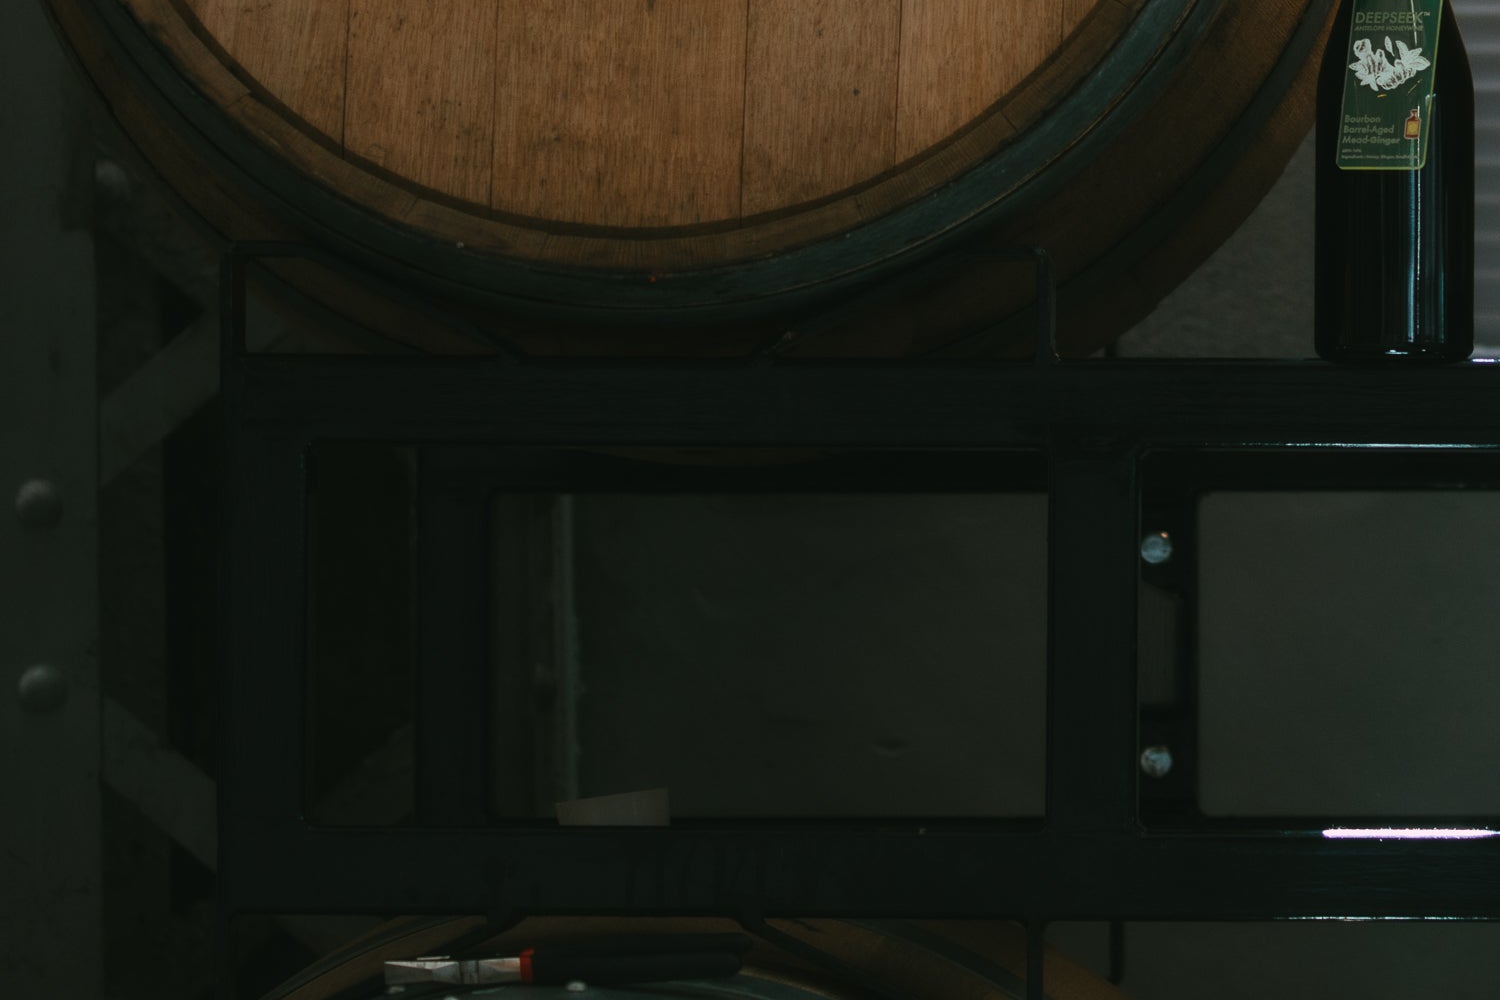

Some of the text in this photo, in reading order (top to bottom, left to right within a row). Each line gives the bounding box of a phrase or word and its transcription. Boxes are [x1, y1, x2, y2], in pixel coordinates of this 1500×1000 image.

[1344, 114, 1381, 124] Bourbon
[1343, 124, 1395, 135] Barrel-Aged
[1342, 135, 1401, 146] Mead-Ginger
